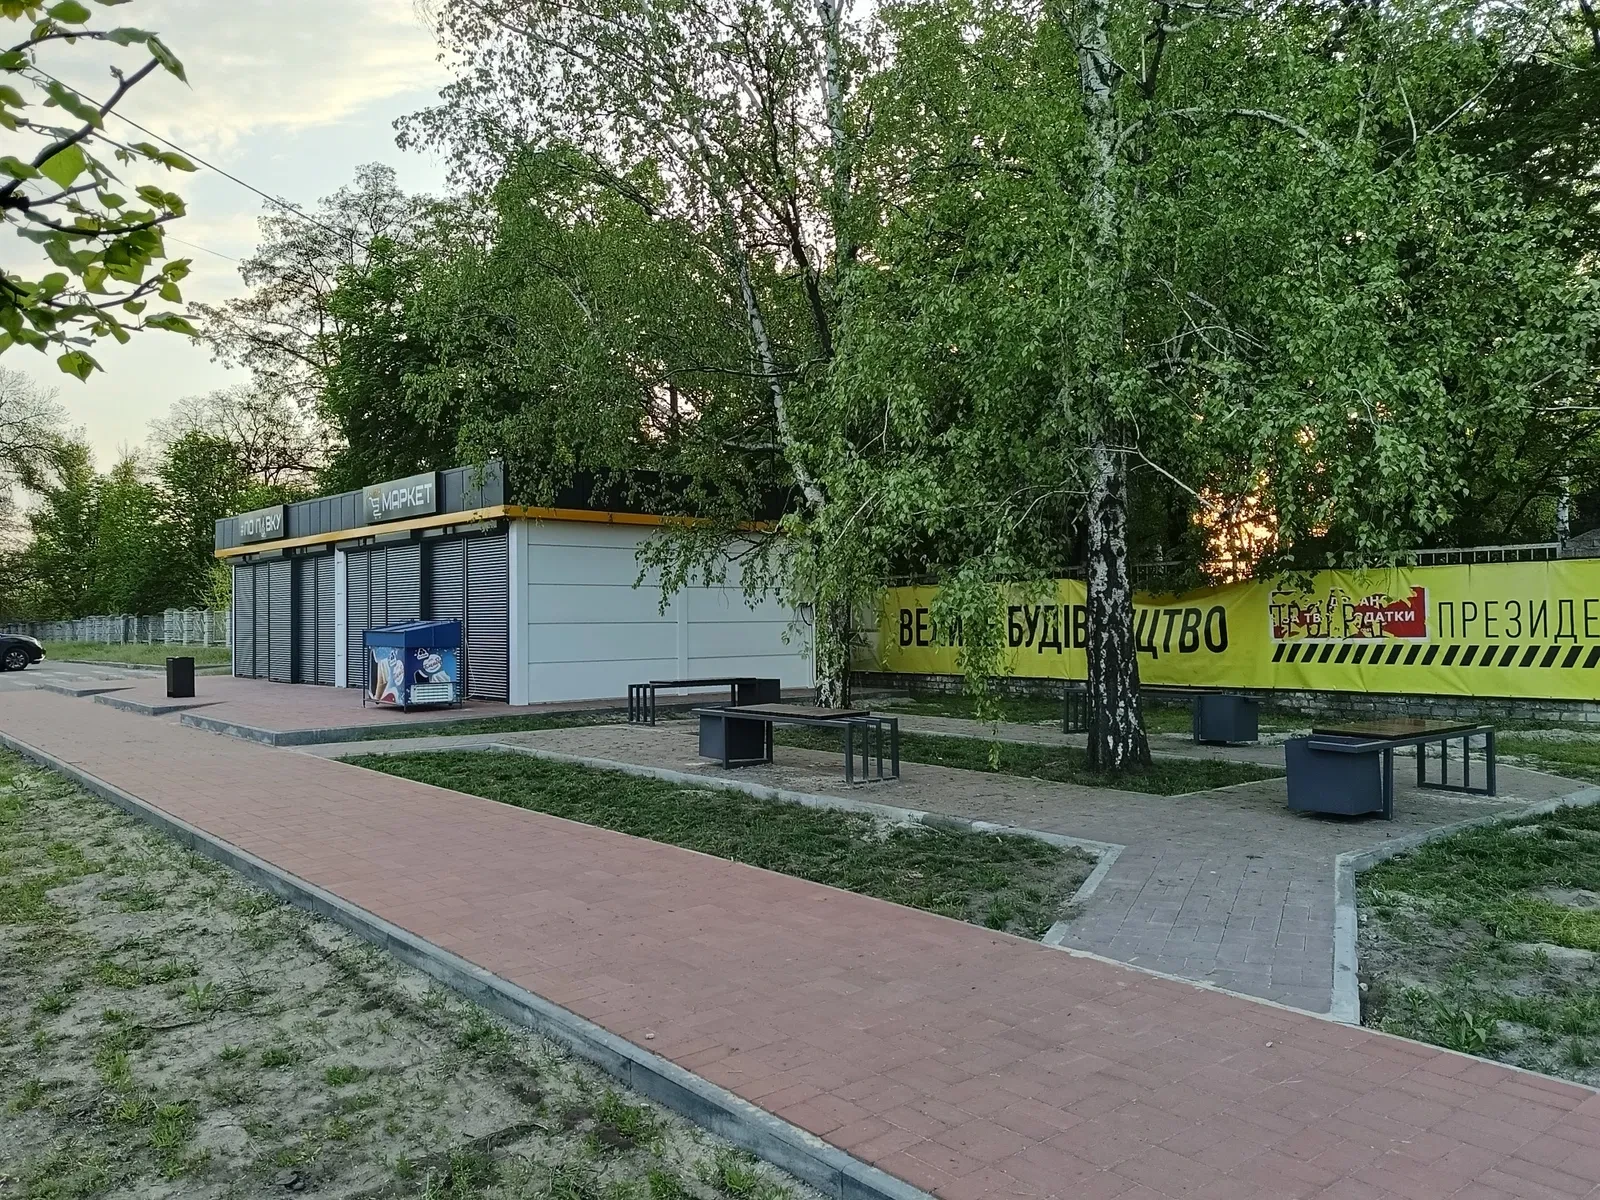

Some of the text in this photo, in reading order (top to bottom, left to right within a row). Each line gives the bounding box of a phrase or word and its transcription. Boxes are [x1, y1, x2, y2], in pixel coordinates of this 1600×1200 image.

[382, 482, 433, 511] МАРКЕТ
[1007, 604, 1228, 660] БУДІВЦТВО
[1353, 610, 1415, 626] ОДАТКИ
[1438, 598, 1600, 644] ПРЕЗИДЕ
